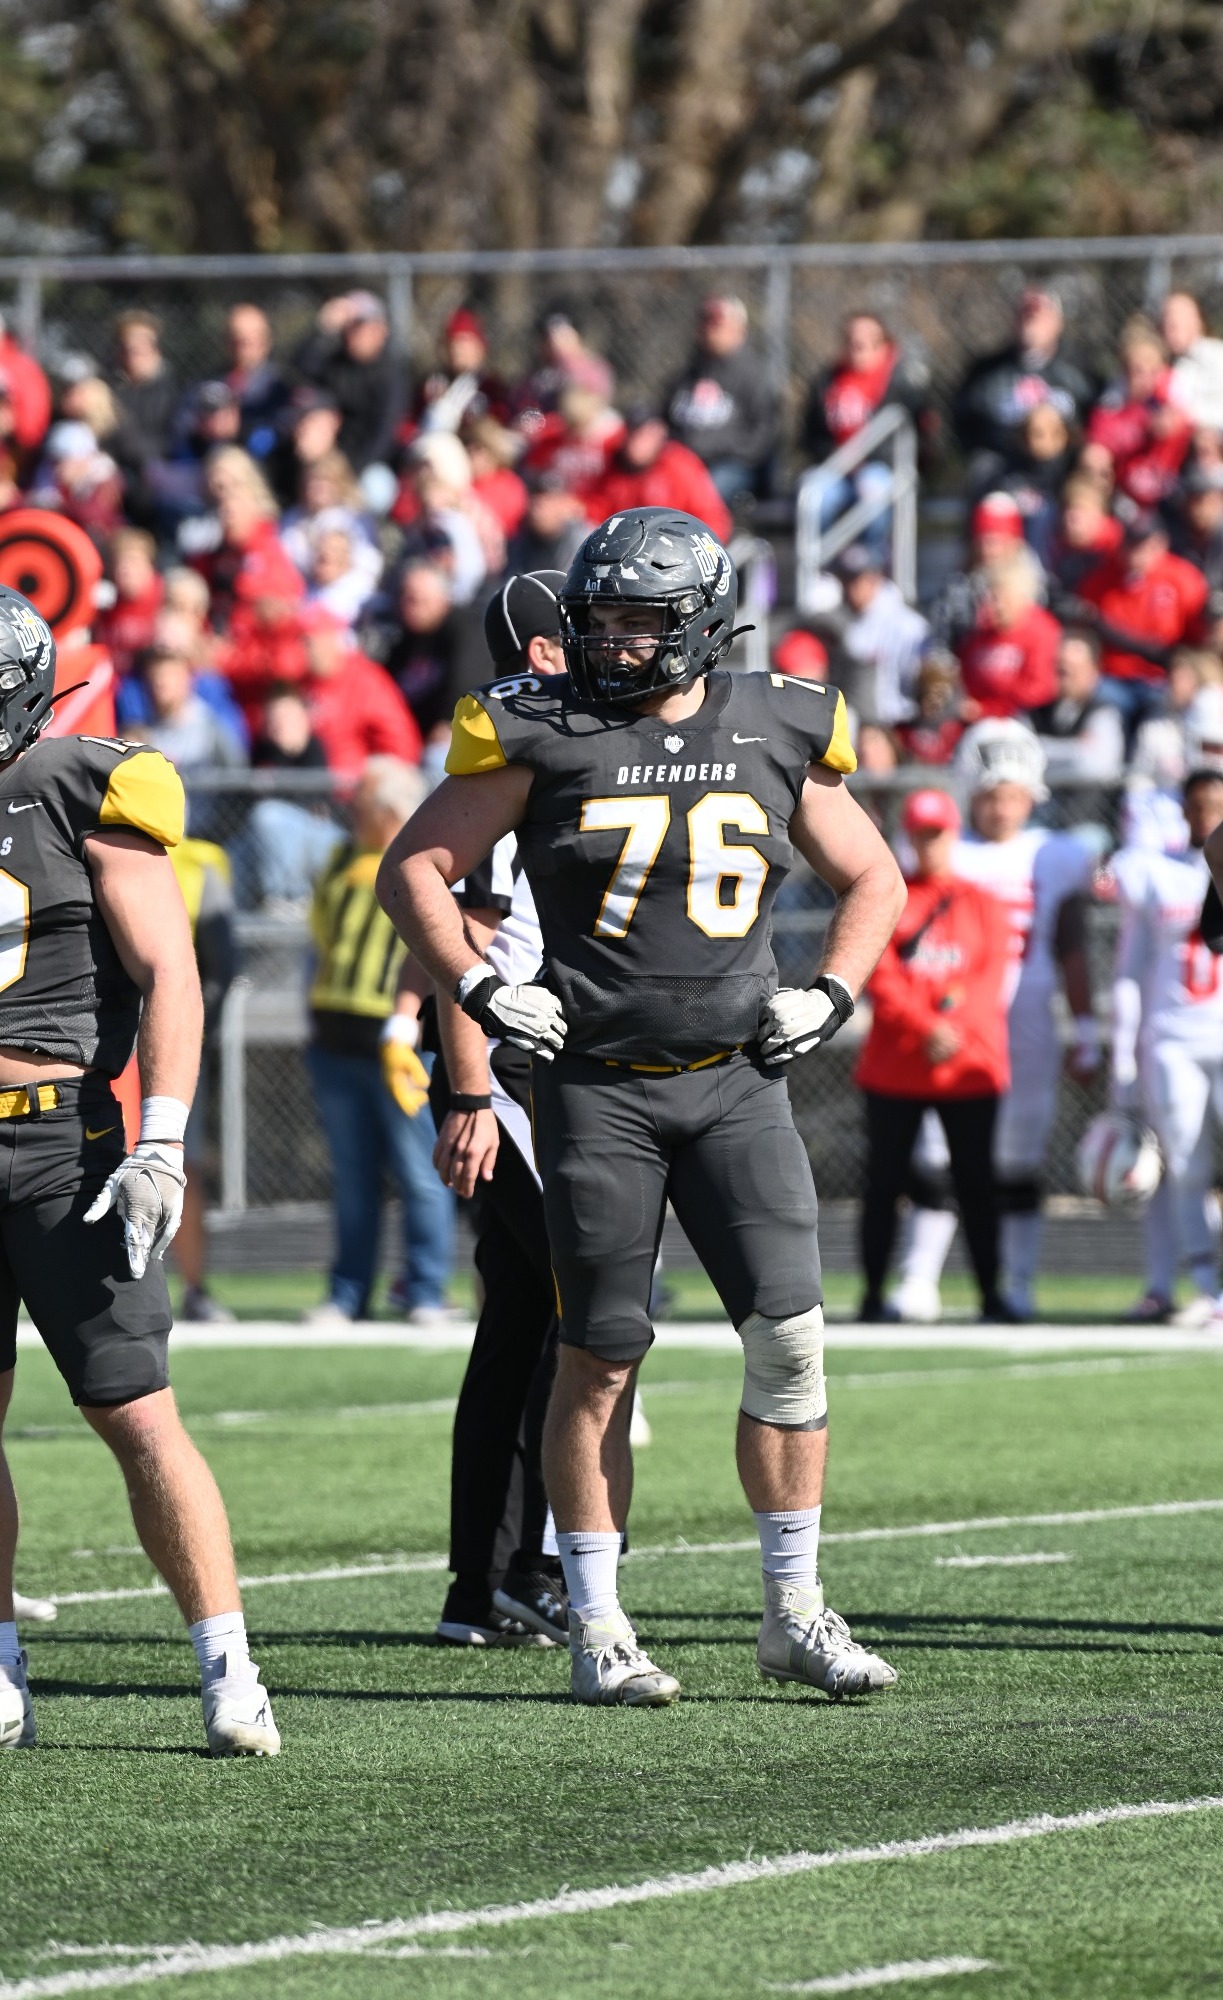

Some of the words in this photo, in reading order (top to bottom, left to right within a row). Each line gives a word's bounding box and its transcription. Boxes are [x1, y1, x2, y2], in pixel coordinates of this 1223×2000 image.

[488, 677, 543, 700] 6
[769, 672, 827, 696] 7
[616, 762, 737, 785] DEFENDERS
[578, 791, 771, 938] 76
